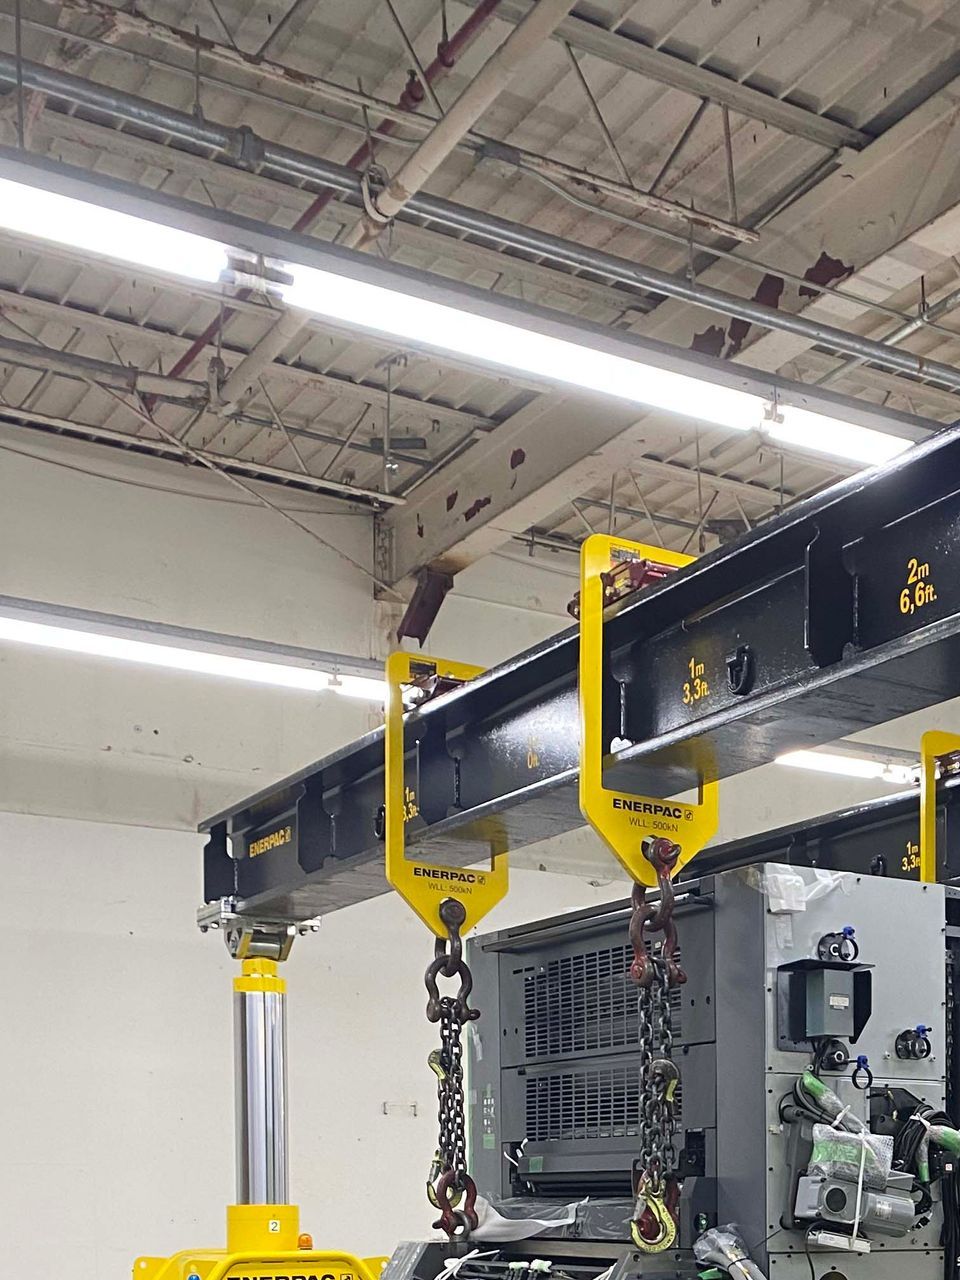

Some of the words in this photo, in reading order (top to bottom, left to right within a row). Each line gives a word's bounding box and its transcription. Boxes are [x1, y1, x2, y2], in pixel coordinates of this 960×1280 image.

[907, 558, 929, 585] 2m
[900, 581, 937, 615] 6,6ft.
[688, 657, 705, 679] 1m
[682, 678, 710, 705] 3,3ft.
[612, 798, 682, 819] ENERPAC
[652, 820, 679, 832] 500kN
[249, 829, 285, 858] ENERPAC
[413, 867, 476, 883] ENERPAC
[271, 1221, 278, 1232] 2
